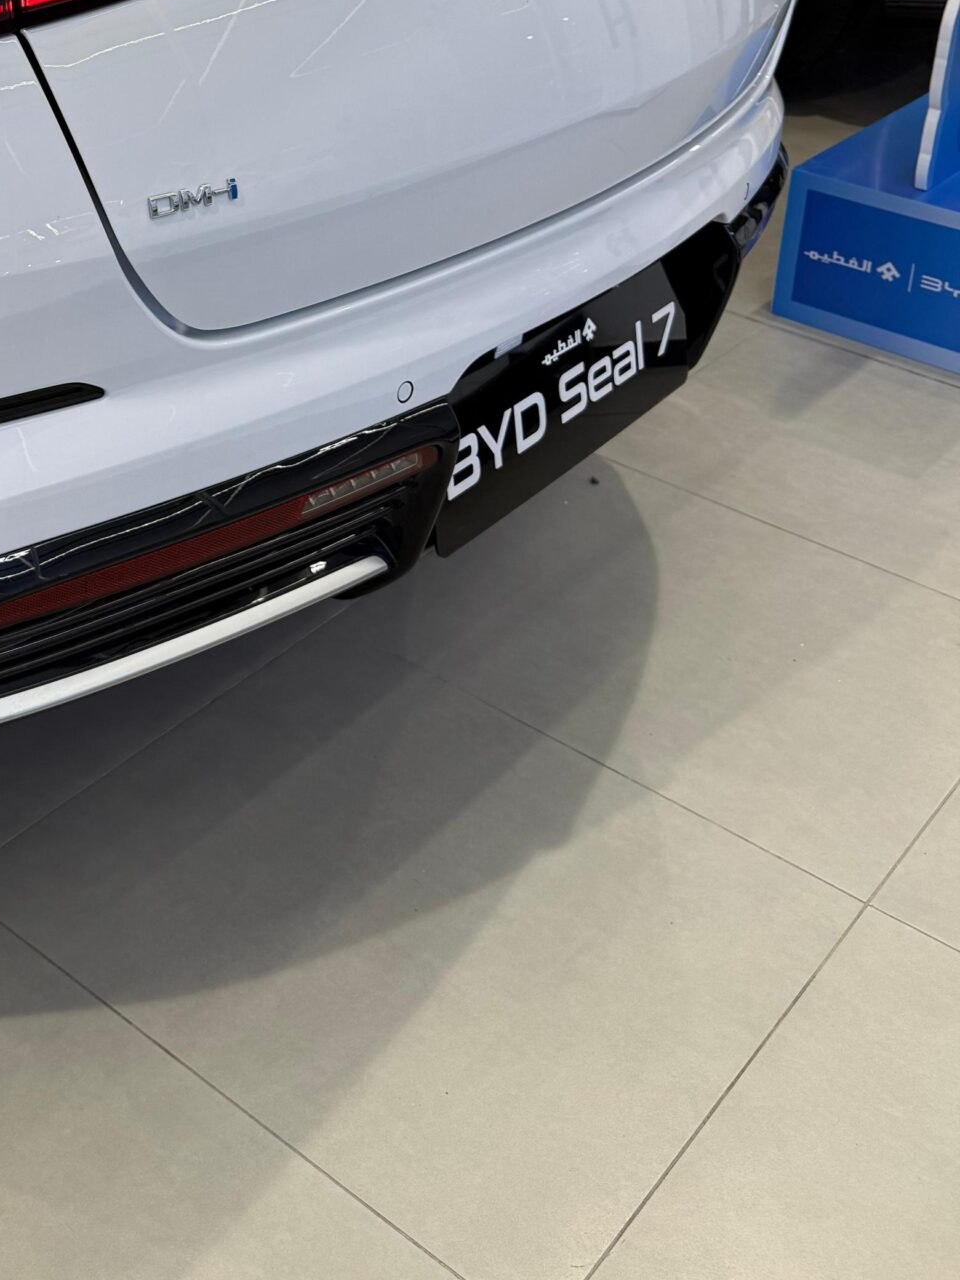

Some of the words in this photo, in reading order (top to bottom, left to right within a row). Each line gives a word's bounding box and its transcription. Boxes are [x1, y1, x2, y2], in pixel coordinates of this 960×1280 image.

[804, 251, 873, 273] الفطيم
[541, 328, 582, 366] الفطيم
[446, 391, 547, 502] BYD
[558, 320, 645, 424] Seal
[651, 300, 676, 357] 7
